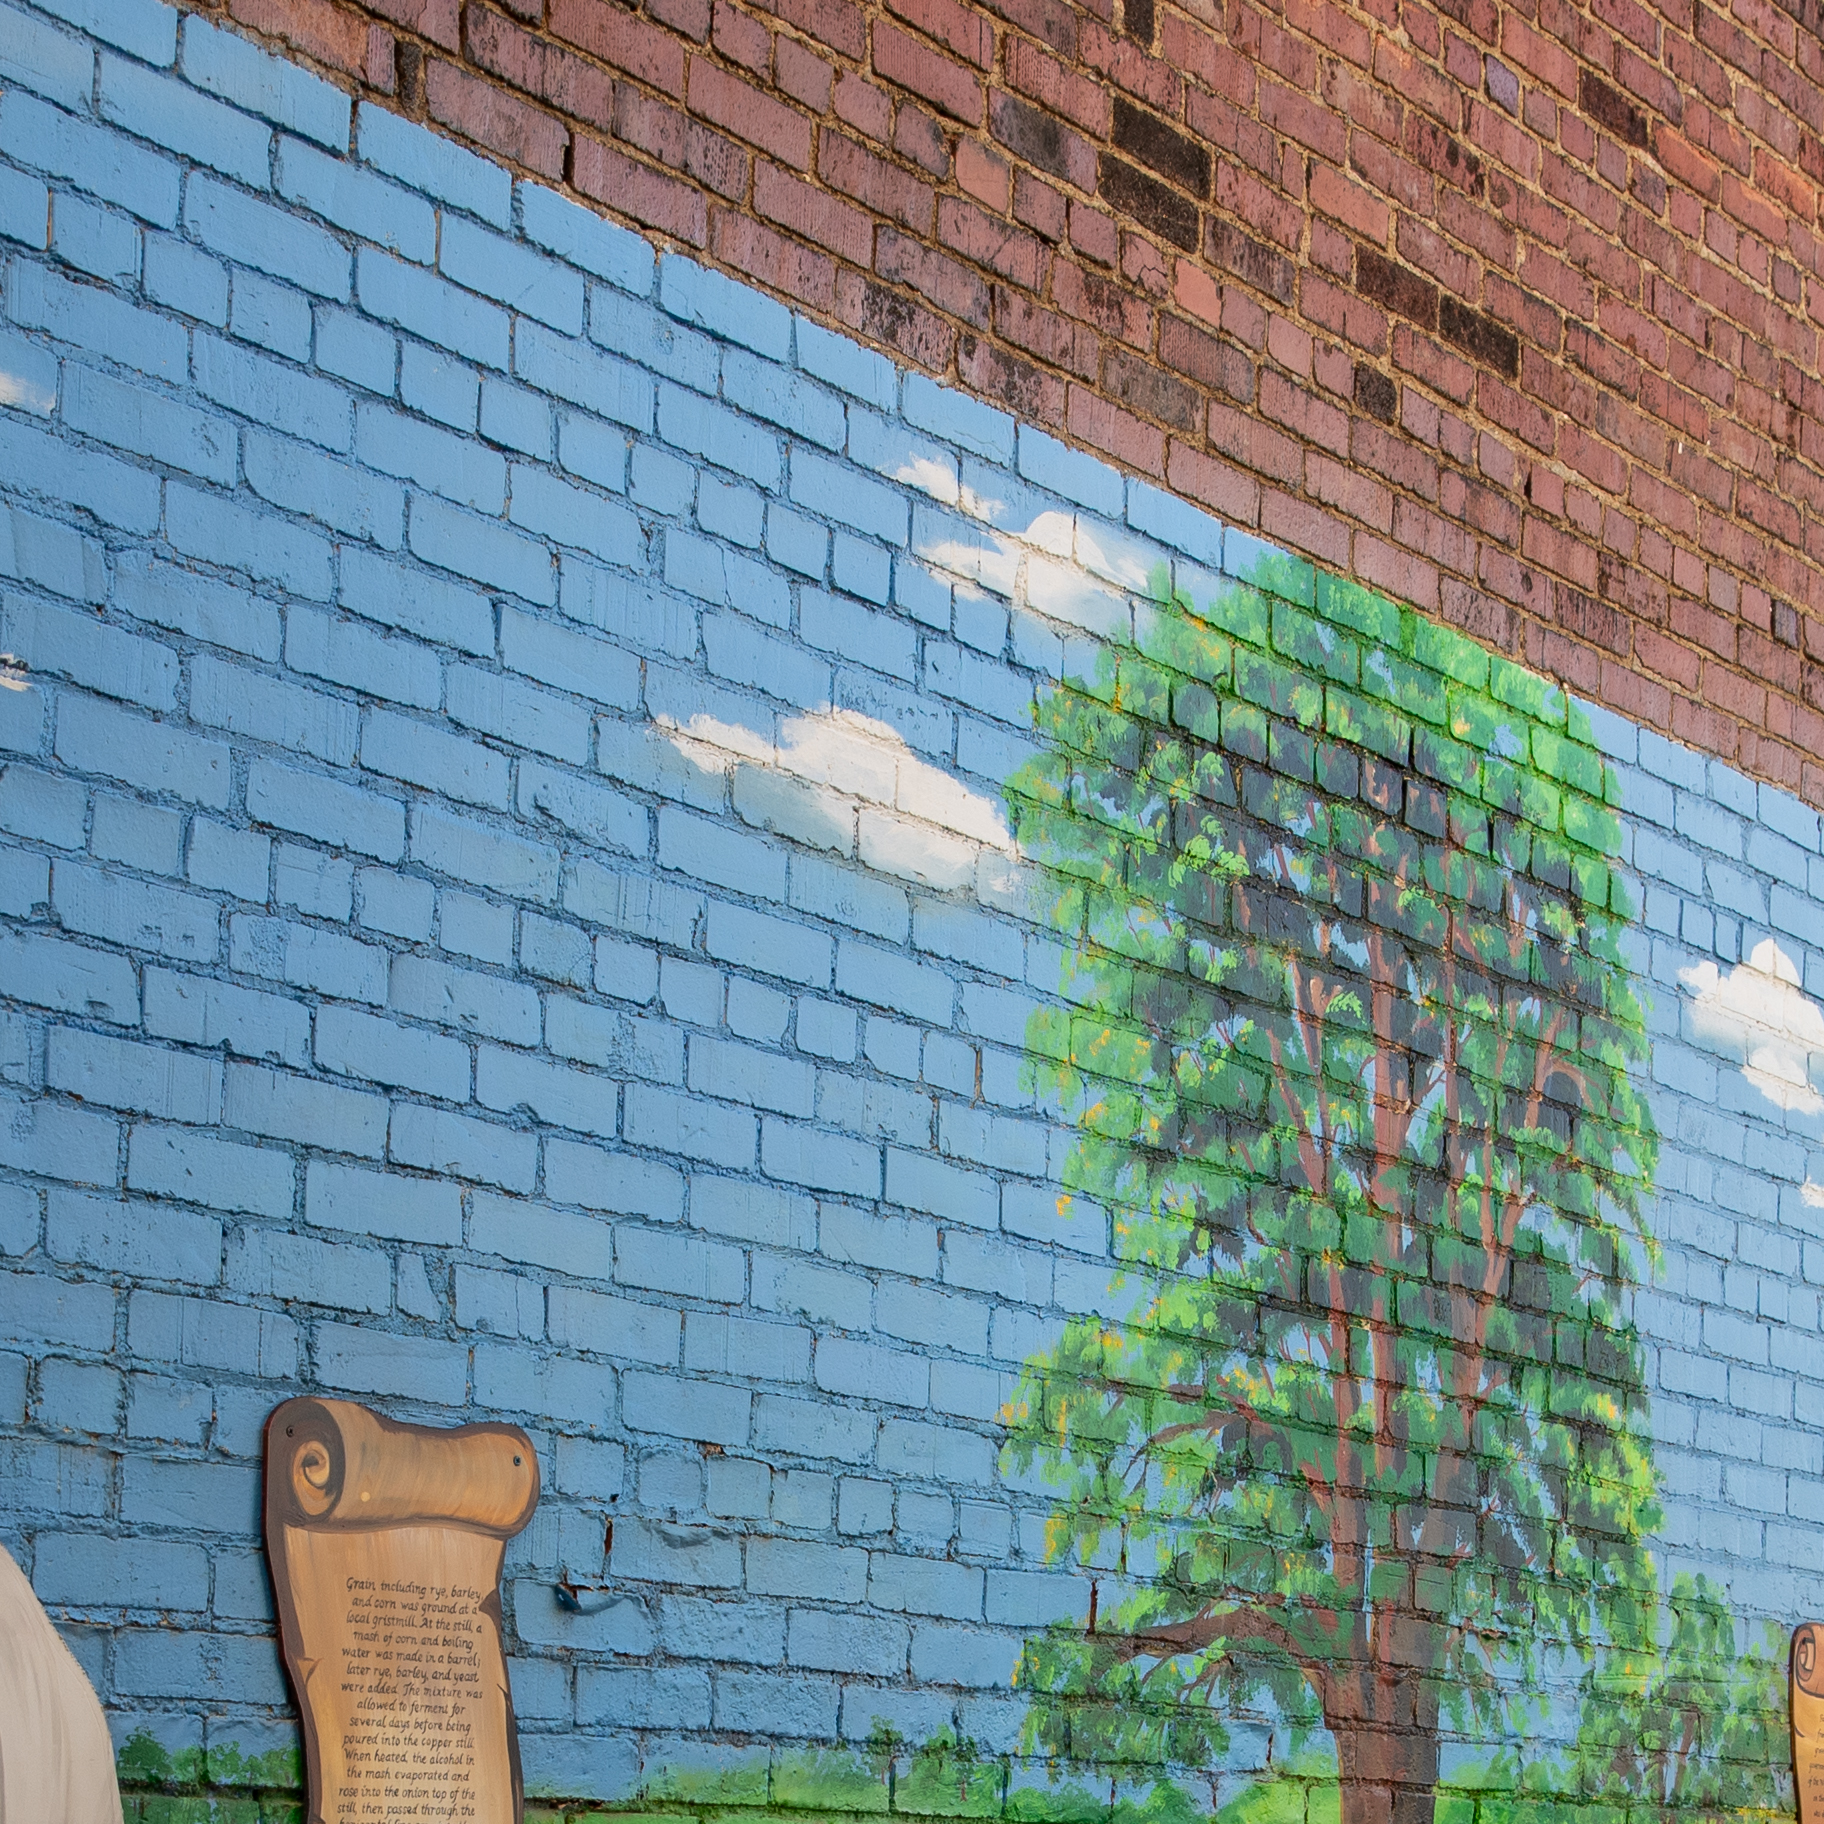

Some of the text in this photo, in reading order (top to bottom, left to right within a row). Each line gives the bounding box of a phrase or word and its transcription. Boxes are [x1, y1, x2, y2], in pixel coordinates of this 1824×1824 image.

[346, 1576, 376, 1592] Grain
[381, 1579, 426, 1599] including
[430, 1587, 448, 1600] rye,
[352, 1595, 373, 1607] and
[375, 1599, 396, 1609] corn
[401, 1602, 419, 1611] was
[422, 1602, 457, 1616] ground
[459, 1605, 468, 1614] at
[347, 1610, 370, 1624] local
[420, 1617, 433, 1628] At
[436, 1616, 450, 1630] the
[476, 1625, 482, 1633] a
[354, 1631, 473, 1653] mash of corn and boiling
[342, 1648, 370, 1658] water
[375, 1651, 393, 1659] was
[397, 1649, 422, 1662] made
[426, 1654, 435, 1663] in
[448, 1652, 480, 1668] barrel;
[347, 1661, 370, 1675] later
[373, 1668, 392, 1678] rye,
[432, 1668, 452, 1680] and
[454, 1673, 479, 1685] yeast
[341, 1682, 364, 1692] were
[403, 1682, 420, 1696] The
[424, 1686, 461, 1698] mixture
[466, 1690, 483, 1699] was
[357, 1697, 466, 1717] allowed to ferment for
[349, 1716, 471, 1736] several days before being
[342, 1733, 379, 1748] poured
[381, 1732, 401, 1746] into
[404, 1734, 418, 1746] the
[422, 1739, 452, 1751] copper
[344, 1748, 371, 1762] When
[413, 1752, 426, 1764] the
[430, 1749, 464, 1765] alcohol
[466, 1754, 475, 1766] in
[347, 1765, 470, 1785] the mash evaporated and
[339, 1785, 475, 1803] rose into the onion top of the
[337, 1801, 475, 1820] still, then passed through the
